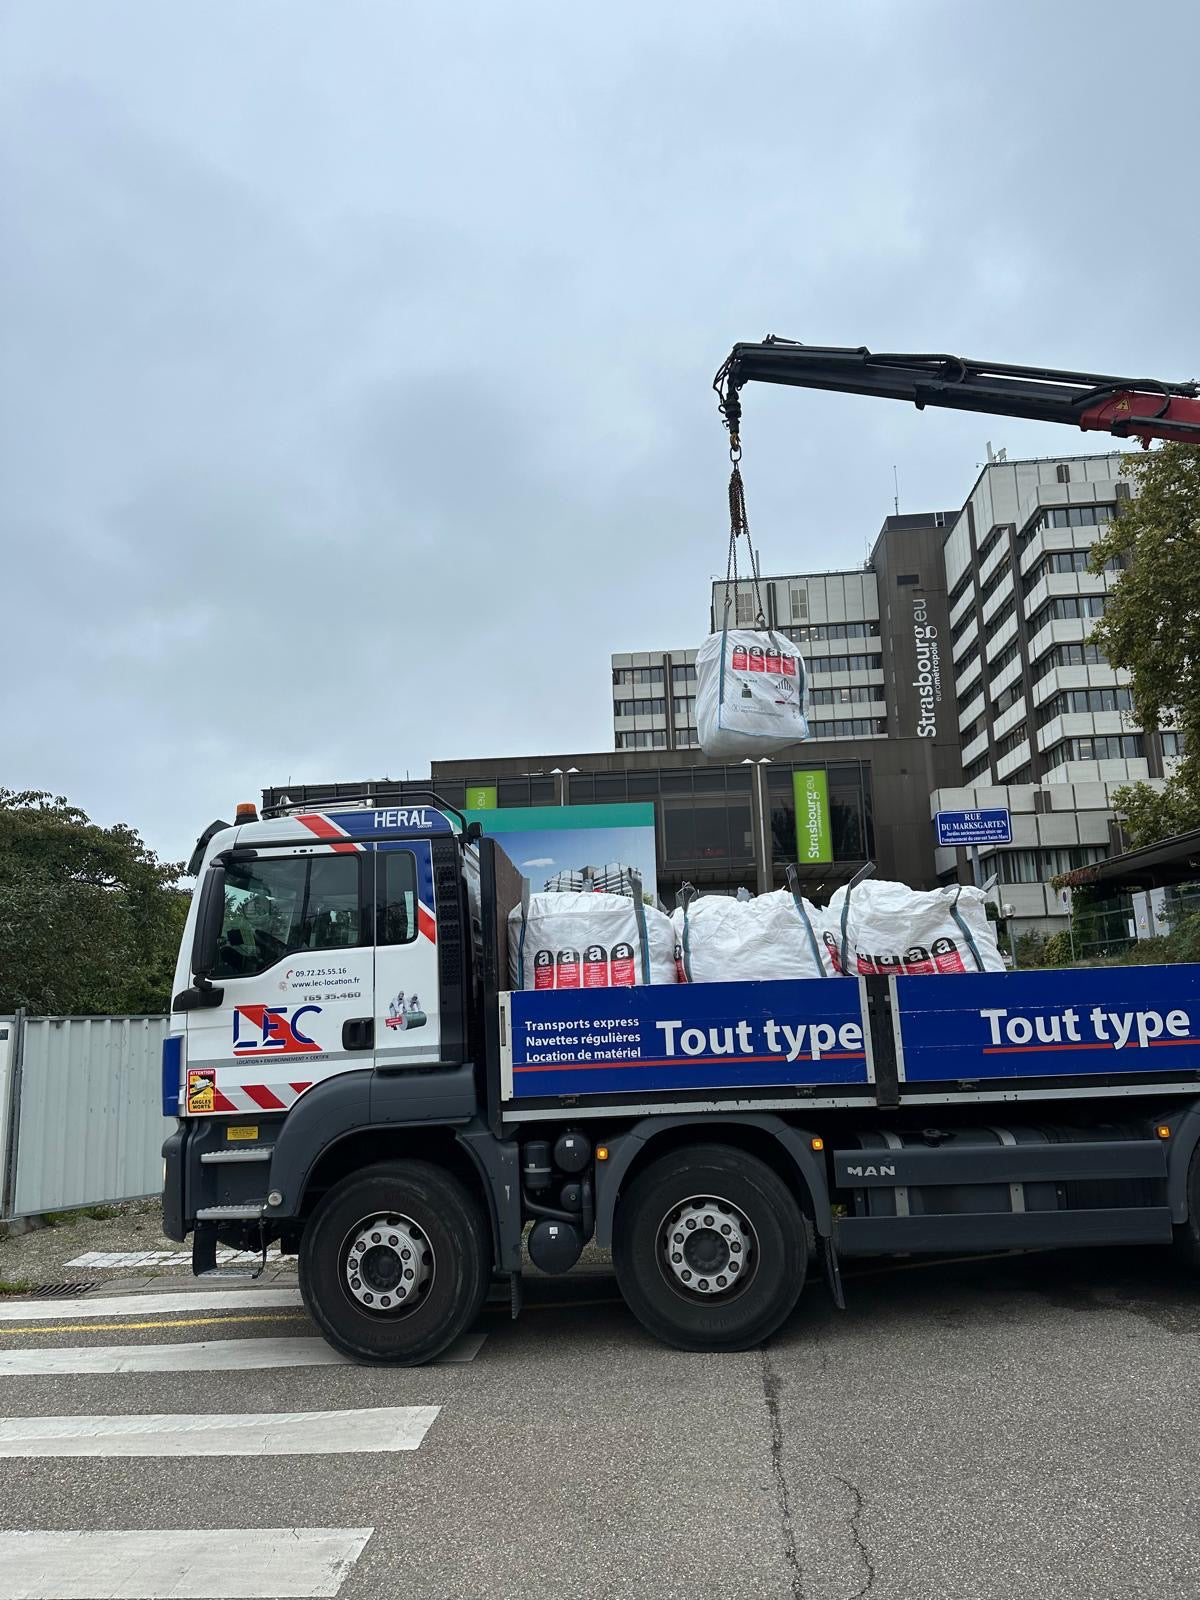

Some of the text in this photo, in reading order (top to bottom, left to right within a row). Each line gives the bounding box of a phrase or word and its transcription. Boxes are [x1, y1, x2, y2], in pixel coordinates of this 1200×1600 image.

[912, 599, 938, 737] Strasbourg.eu
[930, 642, 941, 702] eurométropole
[374, 810, 433, 828] HERAL
[805, 775, 821, 858] Strasbourg.eu
[941, 820, 1007, 831] DU MARKSGARTEN
[539, 945, 629, 965] a a a a
[908, 949, 923, 962] a
[936, 940, 950, 954] a
[295, 968, 347, 977] 09.72.25.55.16
[292, 977, 360, 988] www.lec-location.fr
[324, 992, 361, 1000] 35.460
[233, 1005, 322, 1048] LEC
[525, 1018, 640, 1032] Transports express
[980, 1007, 1190, 1050] Tout type
[526, 1032, 641, 1046] Navettes régulières
[656, 1019, 863, 1062] Tout type
[526, 1047, 641, 1062] Location de matériel
[847, 1166, 895, 1176] MAN
